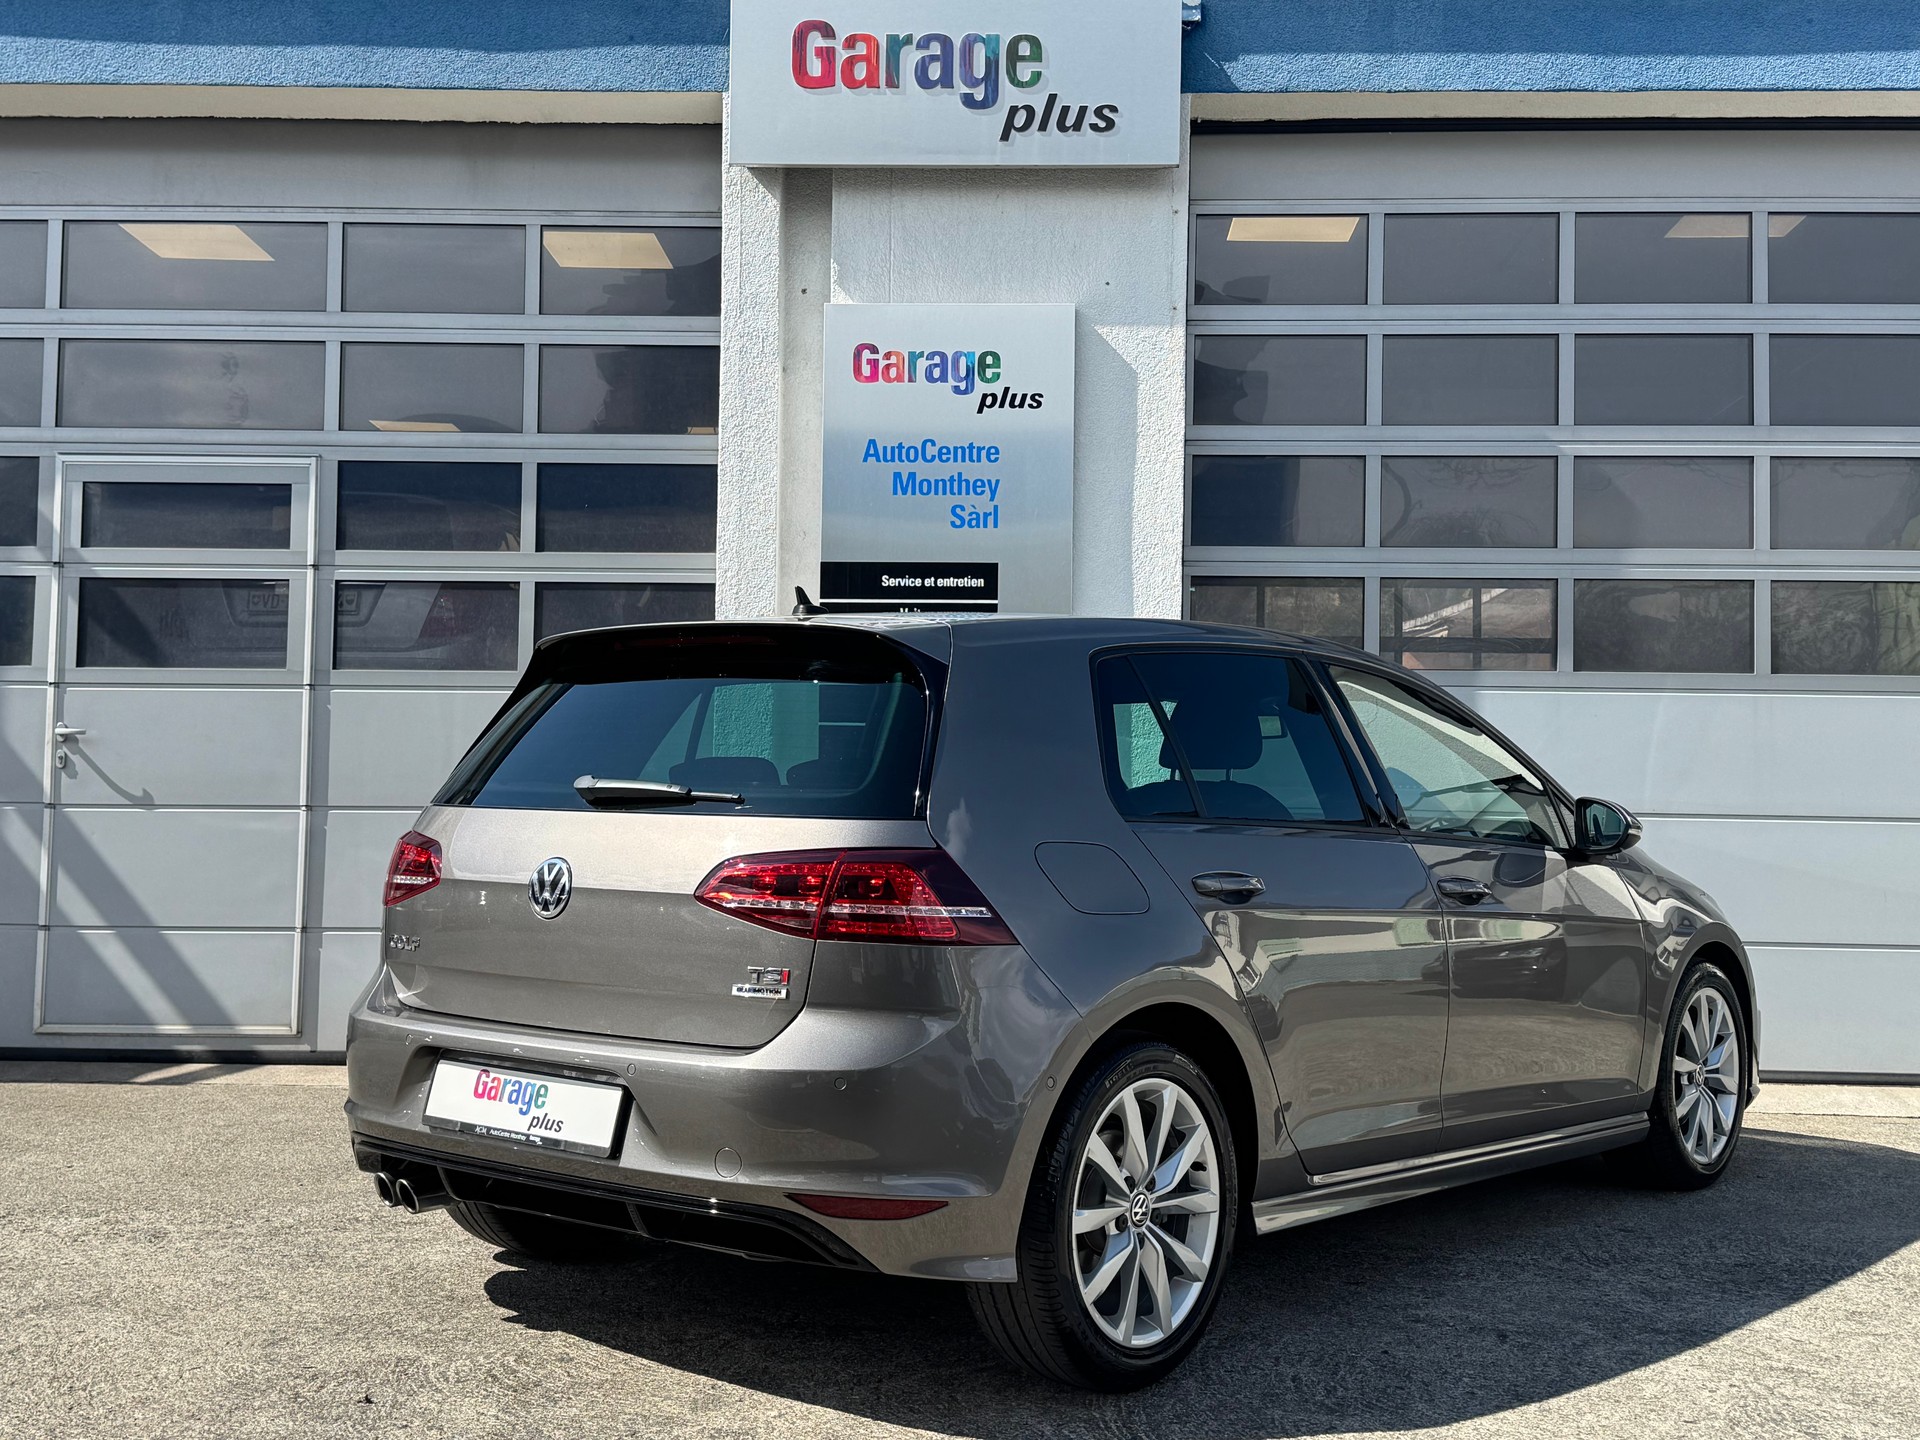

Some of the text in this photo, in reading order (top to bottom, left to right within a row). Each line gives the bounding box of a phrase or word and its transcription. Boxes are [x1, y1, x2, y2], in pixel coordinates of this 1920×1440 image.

[791, 19, 1043, 110] Garage
[999, 93, 1119, 142] plus
[852, 342, 1002, 396] Garage
[976, 386, 1044, 415] plus
[862, 438, 1000, 464] AutoCentre
[892, 471, 1000, 502] Monthey
[950, 504, 999, 529] Sàrl
[881, 575, 985, 588] Service et entretien
[389, 934, 421, 952] GOLF
[747, 965, 790, 985] TSI
[473, 1068, 549, 1116] Garage
[527, 1112, 564, 1133] plus
